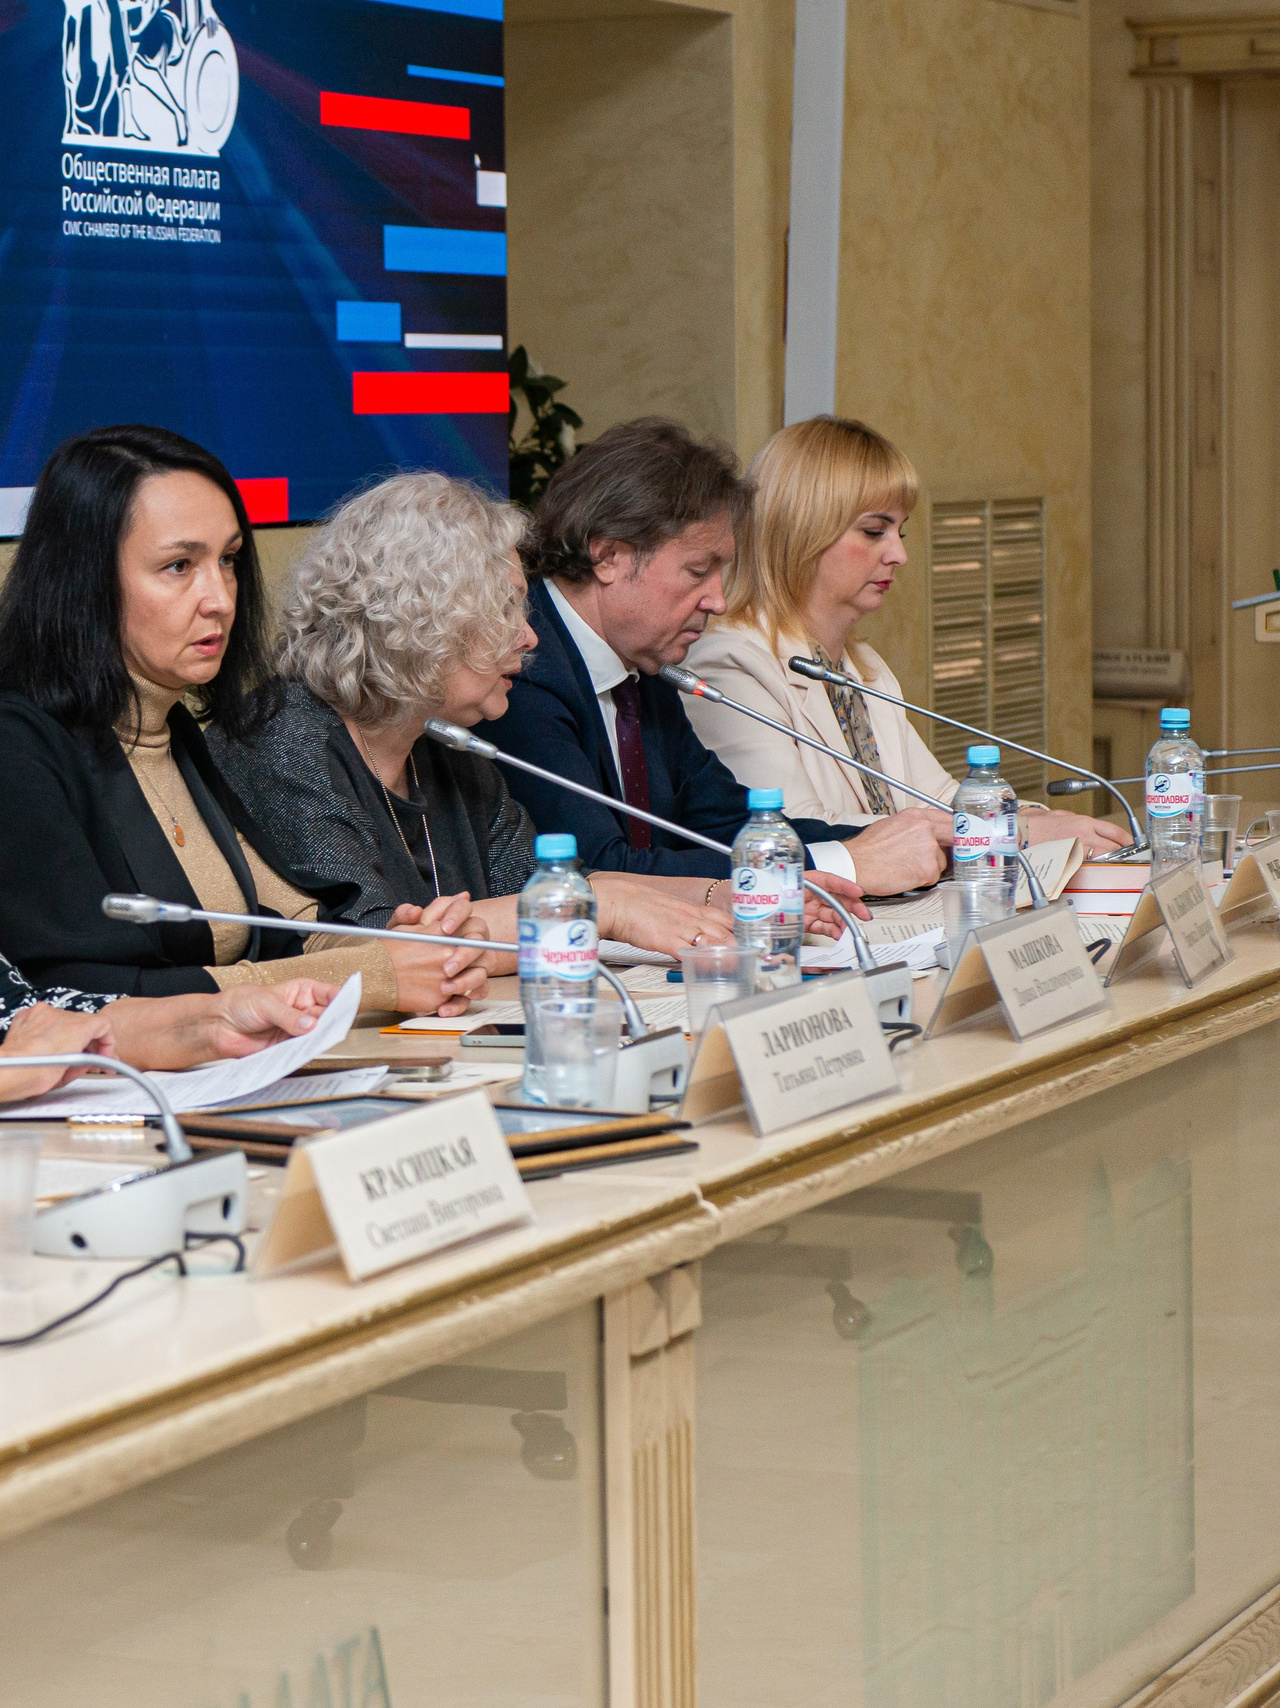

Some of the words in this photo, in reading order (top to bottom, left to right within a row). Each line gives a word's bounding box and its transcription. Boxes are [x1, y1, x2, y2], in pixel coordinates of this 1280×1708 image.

[61, 152, 170, 187] Общественная
[172, 167, 221, 190] палата
[61, 185, 144, 216] Российской
[145, 191, 221, 226] Федерации
[62, 220, 83, 237] CIVIC
[83, 221, 120, 238] CHAMBER
[120, 223, 132, 239] OF
[132, 224, 147, 240] THE
[147, 225, 178, 242] RUSSIAN
[177, 227, 222, 244] FEDERATION
[1007, 933, 1065, 973] МАШКОВА
[760, 1006, 854, 1059] ЛАРИОНОВА
[771, 1065, 820, 1094] Татьяна
[812, 1048, 867, 1081] Петровна
[357, 1135, 478, 1203] КРАСИЦКАЯ
